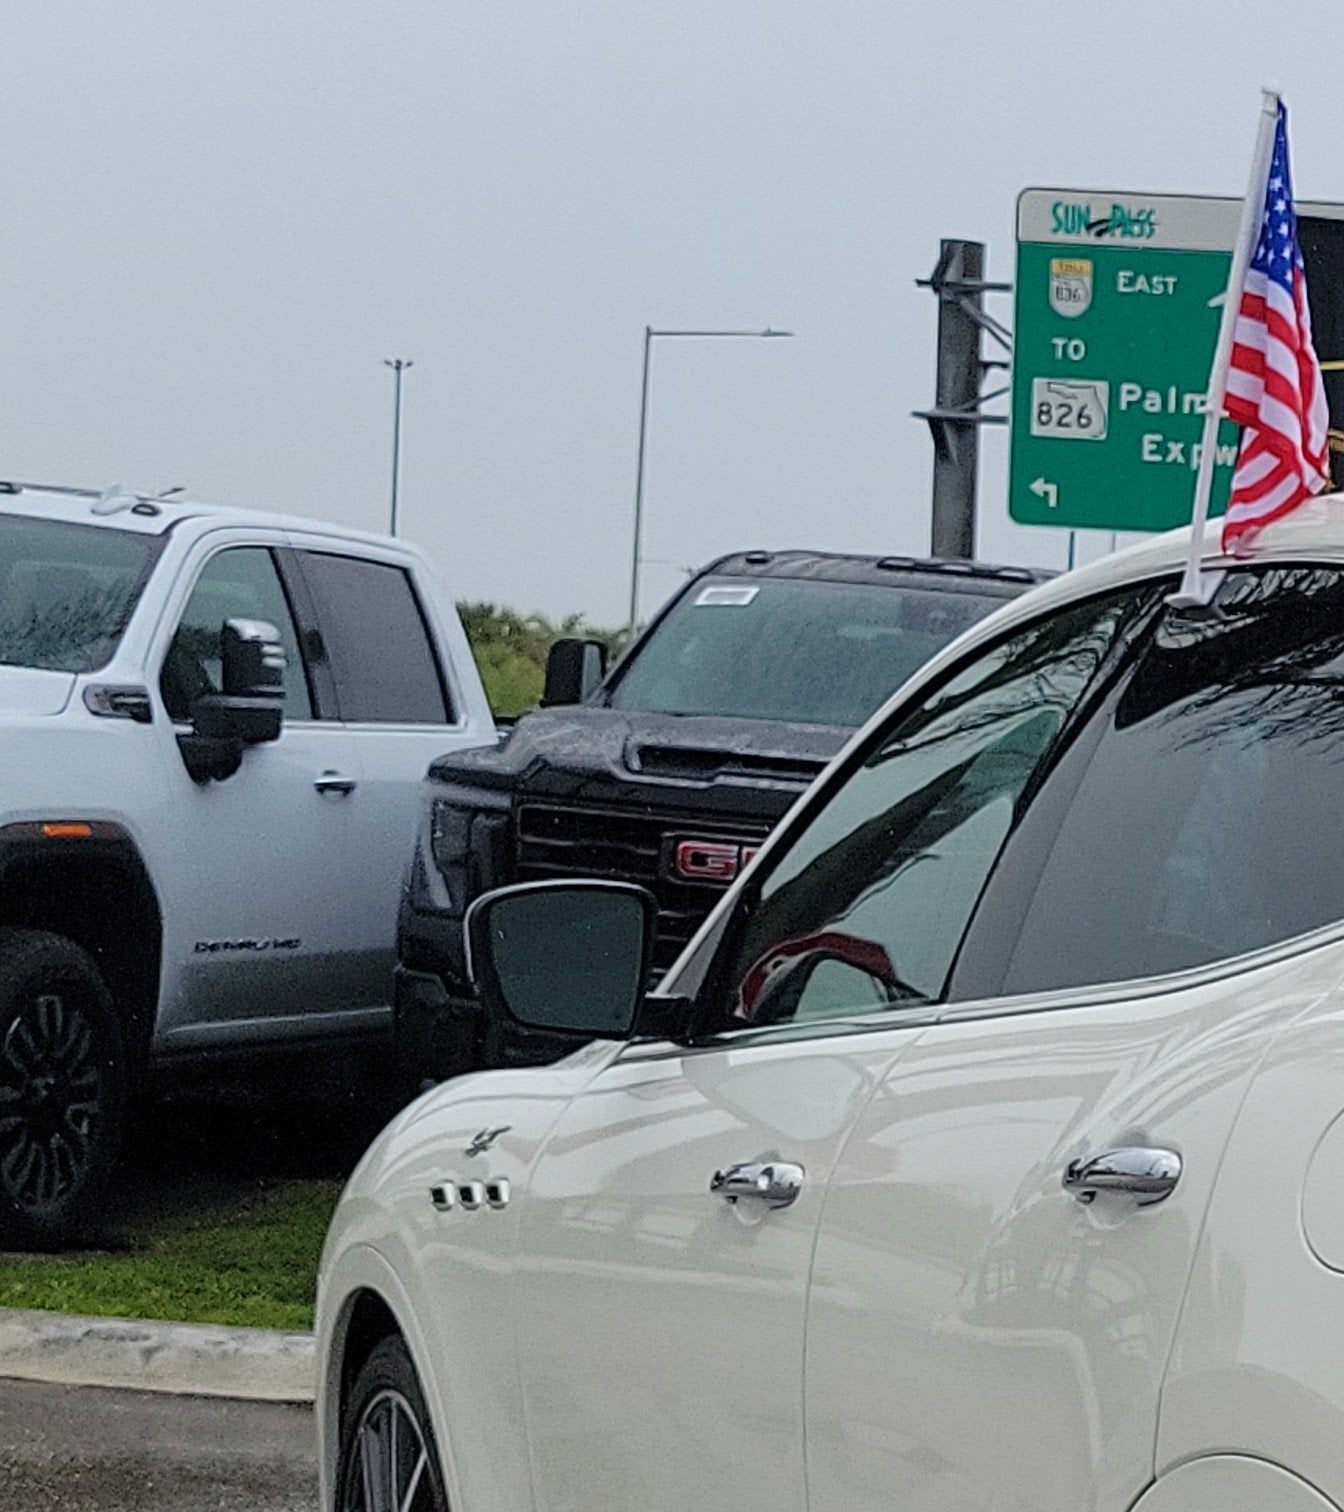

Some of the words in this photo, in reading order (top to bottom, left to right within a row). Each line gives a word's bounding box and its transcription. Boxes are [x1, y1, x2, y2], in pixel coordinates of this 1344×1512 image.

[1117, 270, 1178, 295] EAST
[1051, 337, 1086, 361] TO
[1118, 382, 1208, 415] Palm
[1037, 402, 1092, 428] 826
